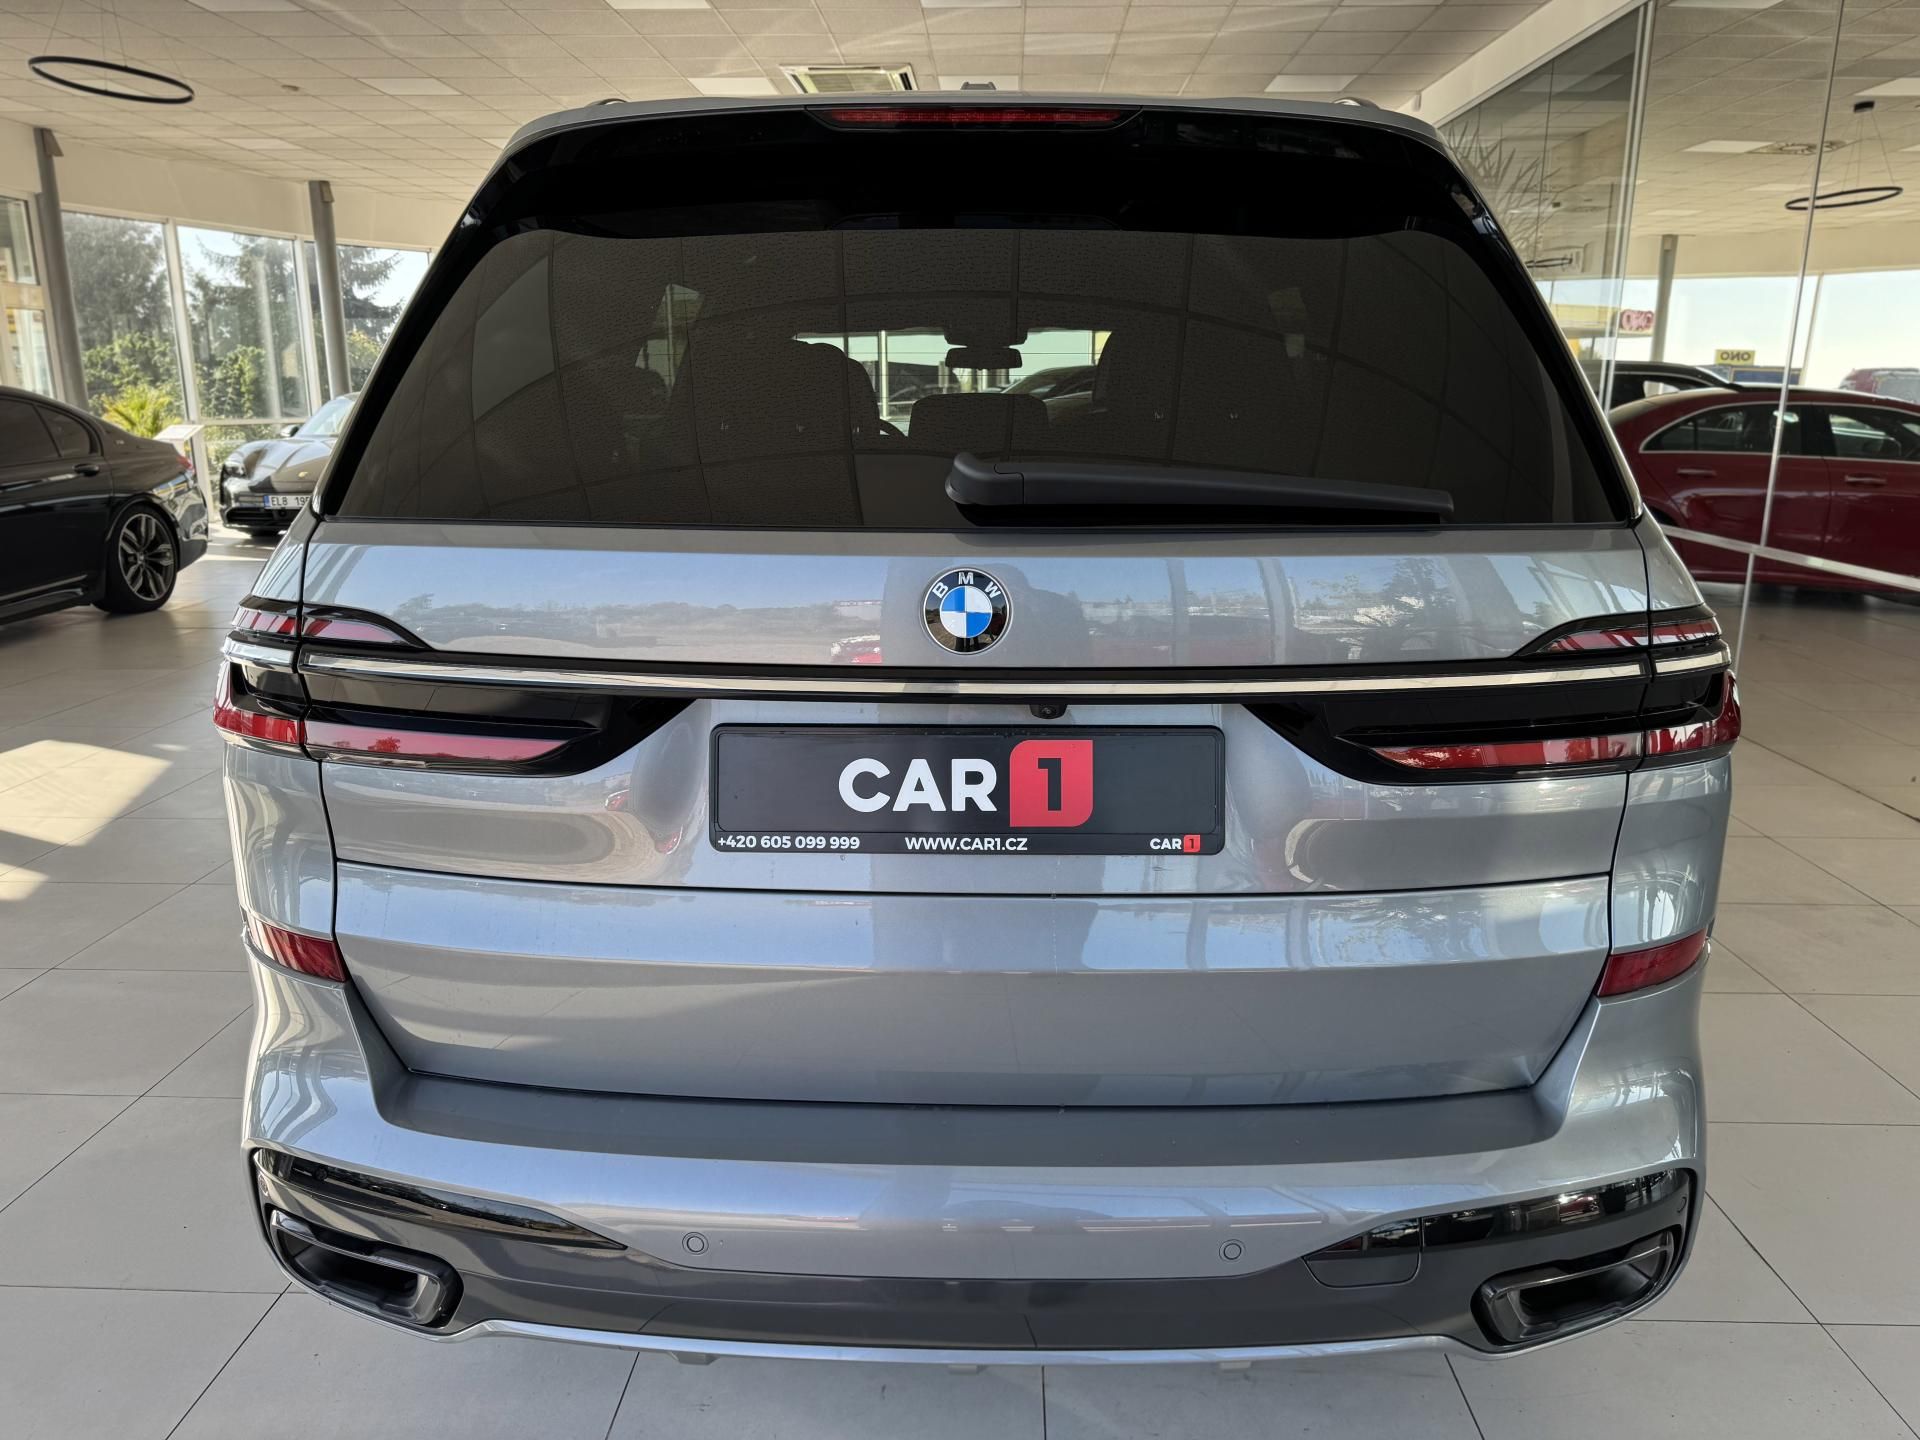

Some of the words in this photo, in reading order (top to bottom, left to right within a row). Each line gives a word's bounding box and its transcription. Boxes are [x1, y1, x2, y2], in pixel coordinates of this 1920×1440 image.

[932, 572, 1001, 598] BMW
[838, 757, 997, 812] CAR
[717, 836, 757, 848] +420
[760, 836, 791, 848] 605
[795, 837, 826, 848] 099
[830, 837, 860, 849] 999
[905, 837, 1028, 850] WWW.CAR1.CZ
[1150, 838, 1182, 850] CAR
